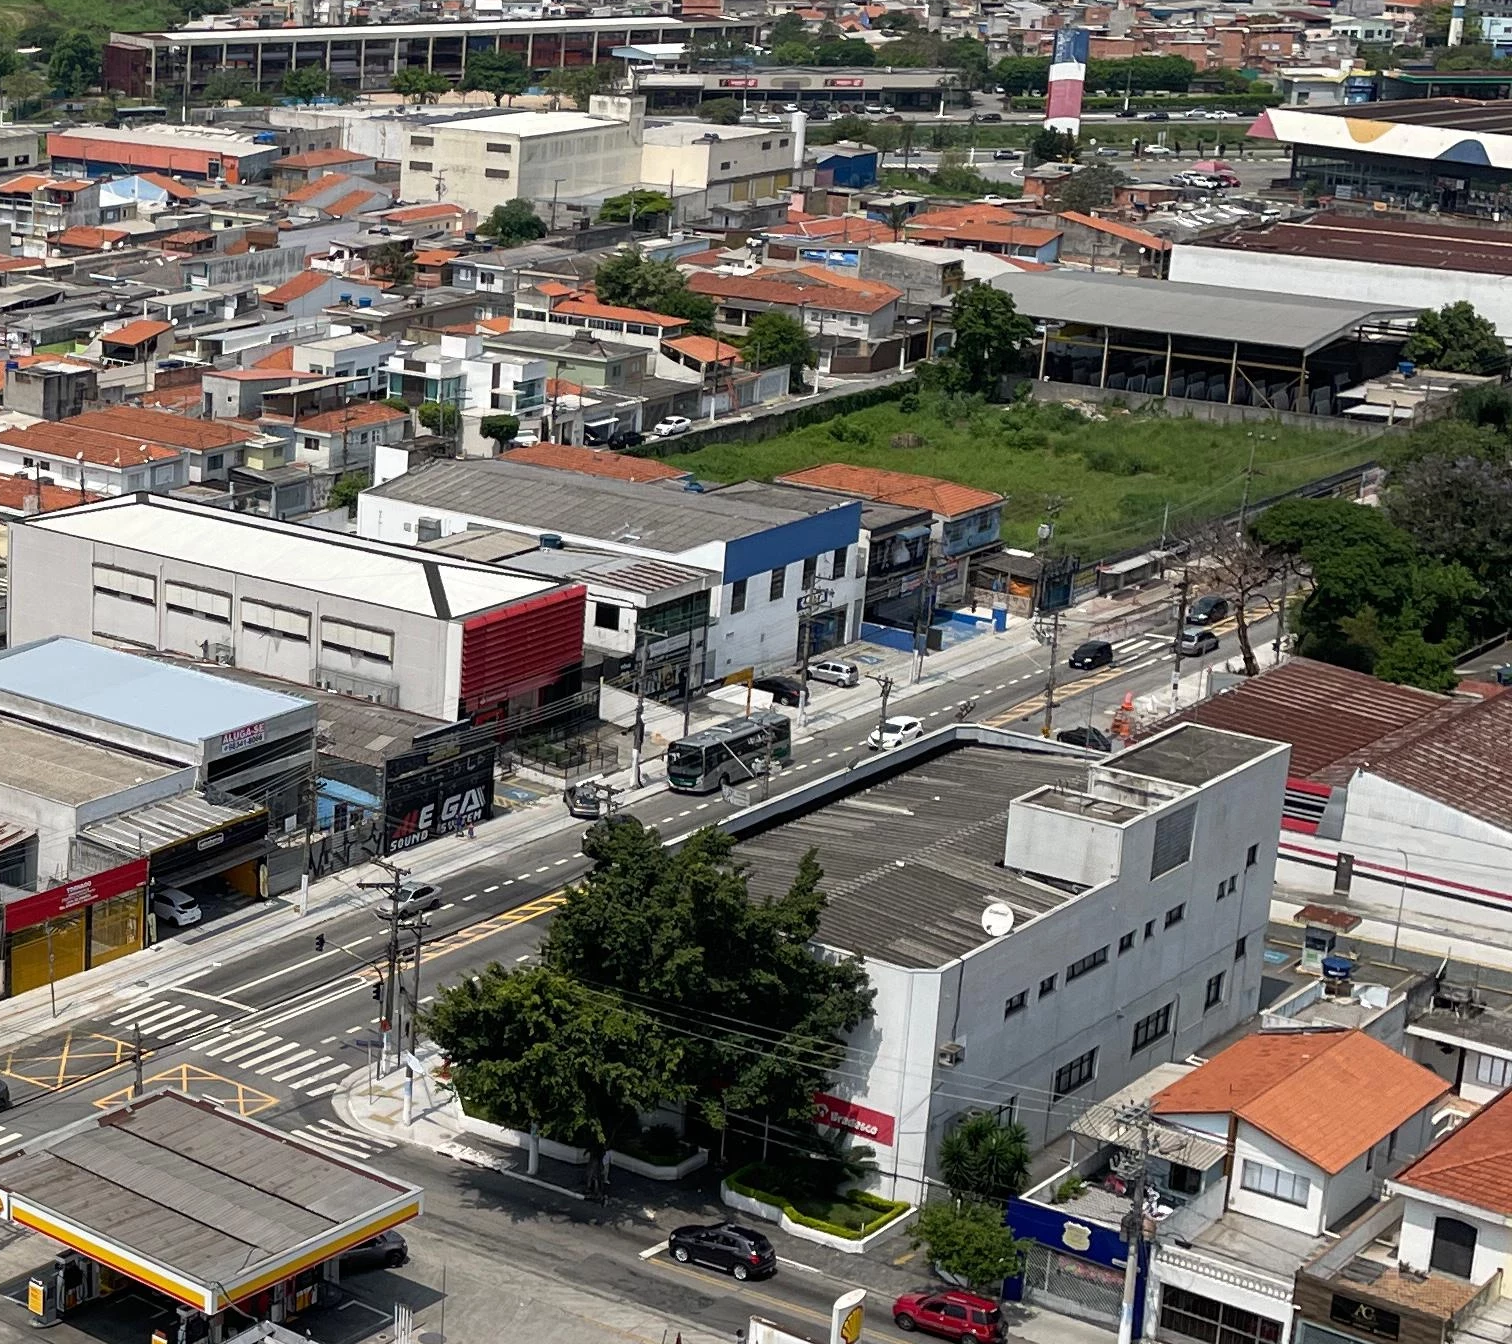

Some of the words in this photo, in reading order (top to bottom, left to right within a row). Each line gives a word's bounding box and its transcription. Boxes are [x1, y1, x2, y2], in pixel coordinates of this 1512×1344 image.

[223, 722, 265, 744] ALUGA-SE
[390, 829, 429, 852] SOUND
[830, 1111, 879, 1136] Bradesco
